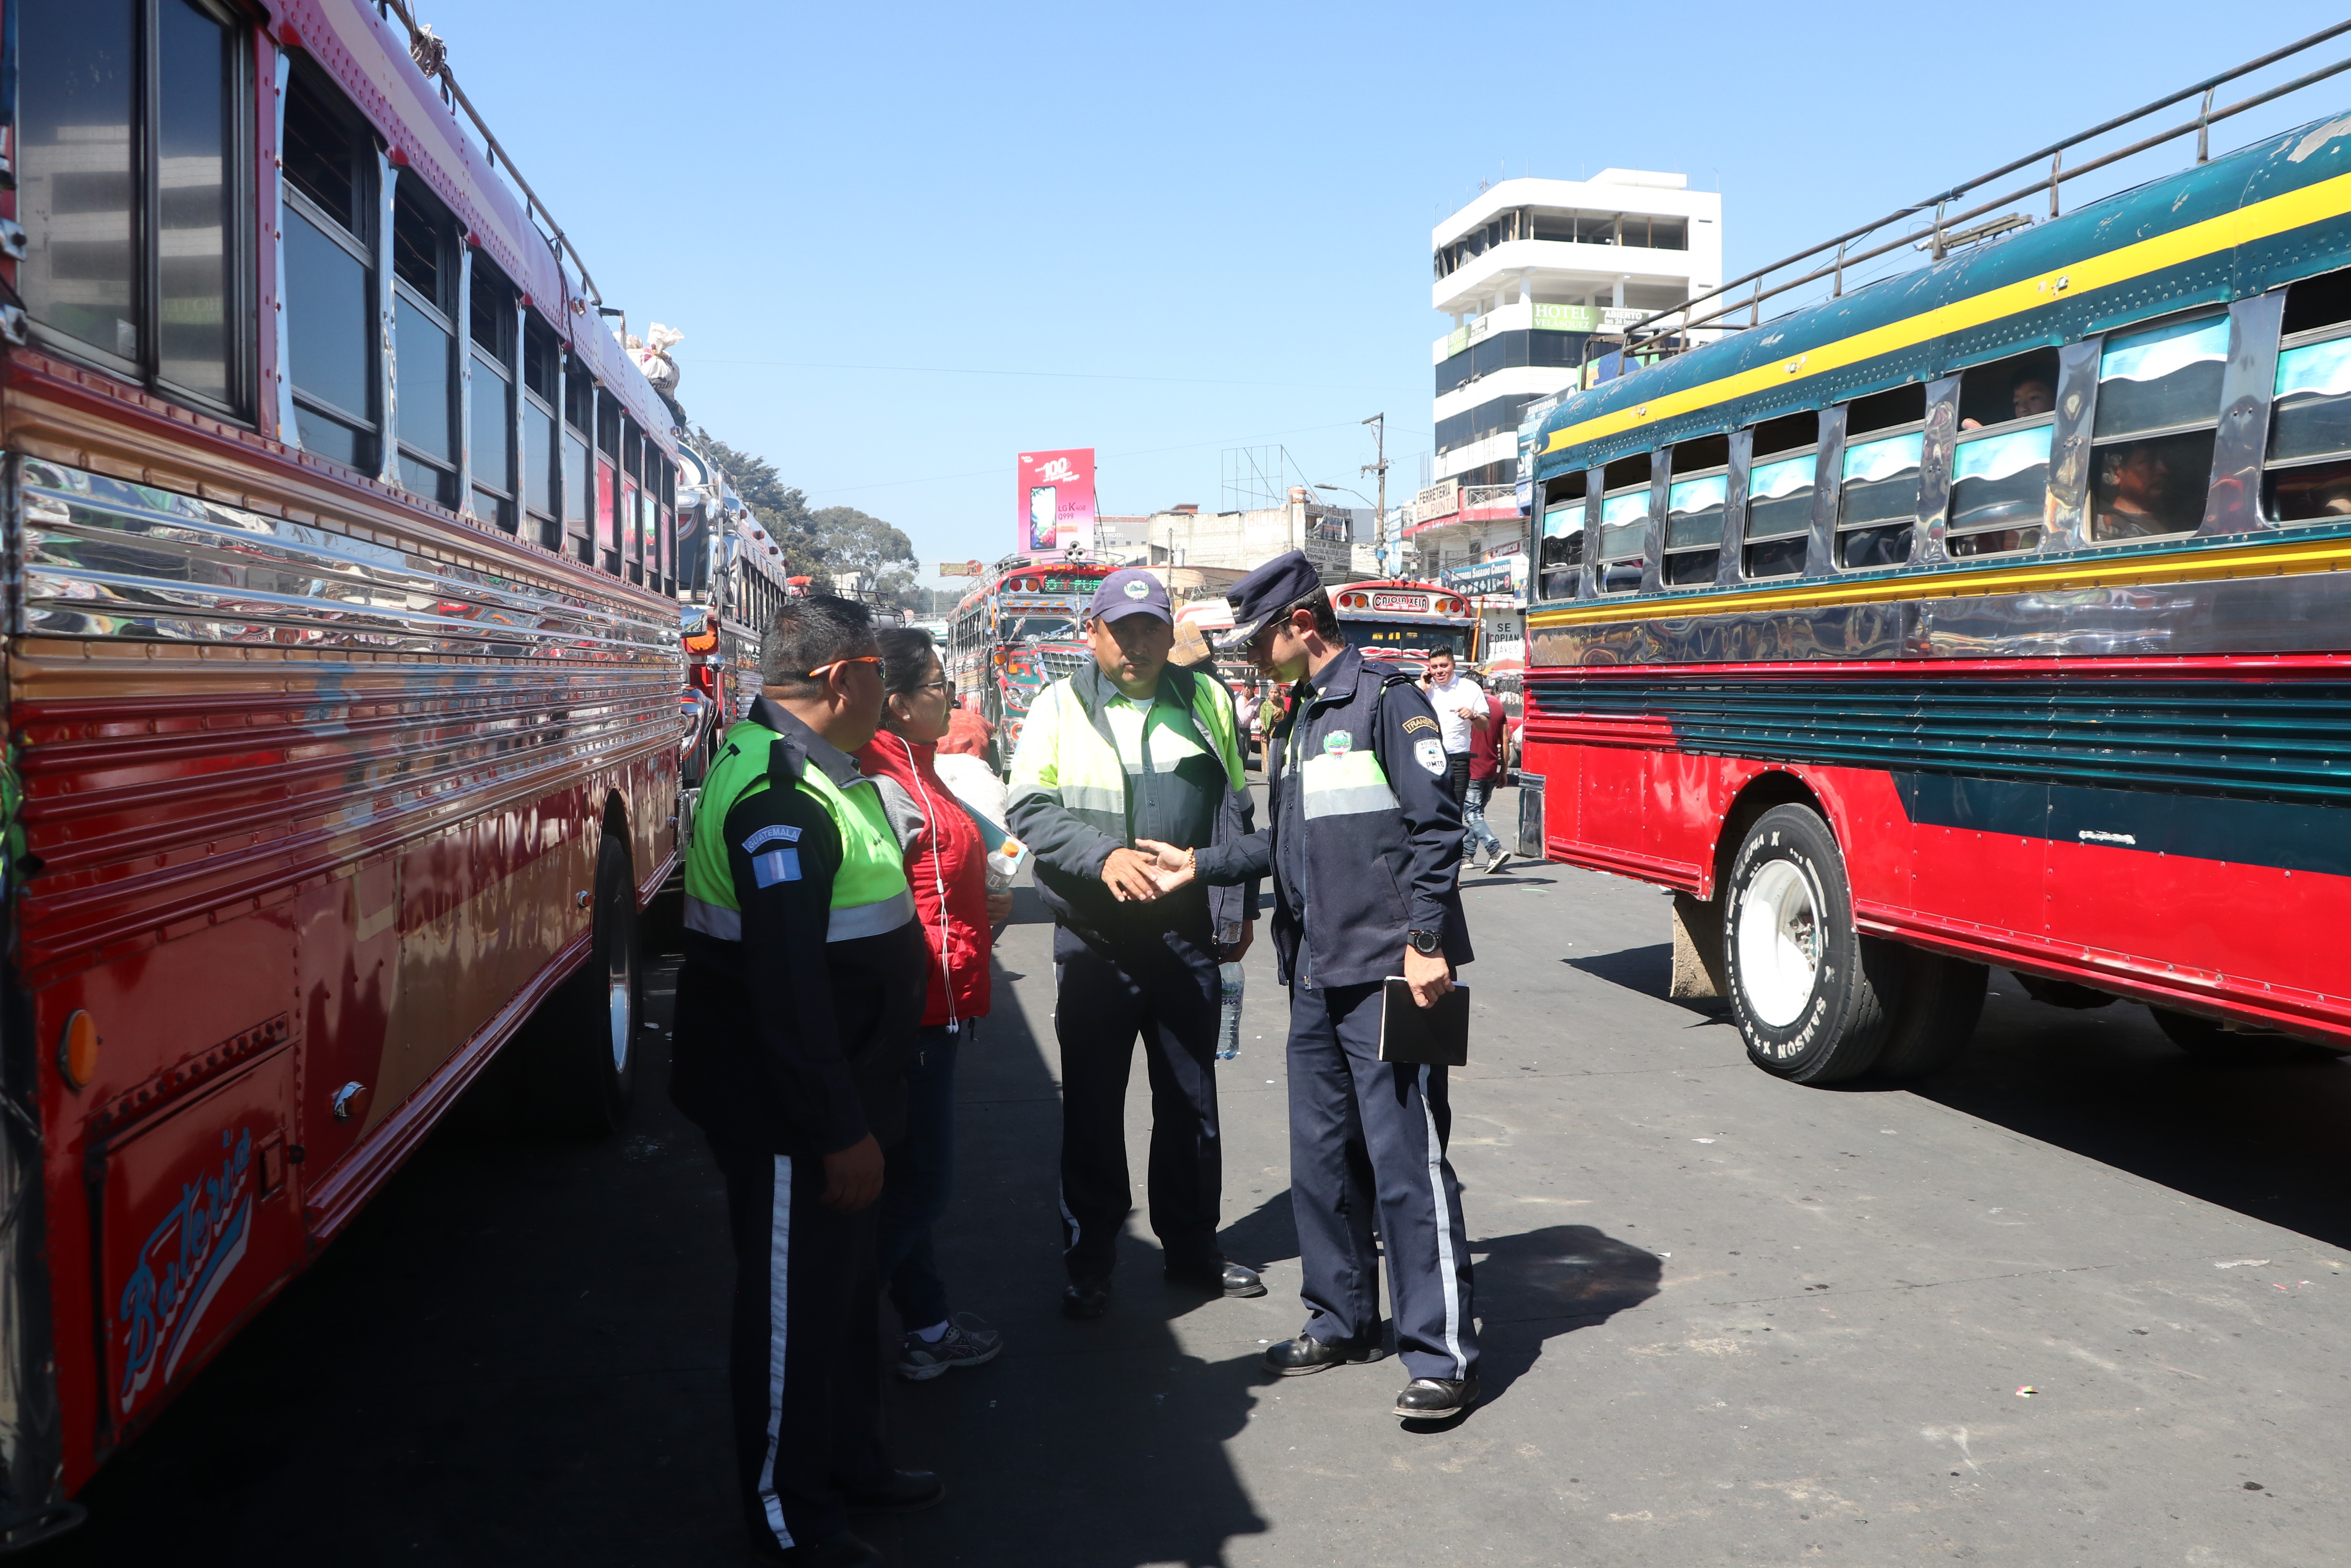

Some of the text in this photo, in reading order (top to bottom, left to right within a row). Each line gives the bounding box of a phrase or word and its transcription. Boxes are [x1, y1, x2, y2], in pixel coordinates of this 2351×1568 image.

[1535, 304, 1589, 320] HOTEL
[1604, 310, 1643, 319] ABIERTO
[1449, 326, 1467, 346] HOTEL
[1527, 397, 1557, 416] SURTIDORA
[1043, 457, 1067, 478] 100
[1419, 483, 1451, 505] FERRETERIA
[1273, 508, 1302, 526] XEA
[1308, 505, 1323, 513] BICI
[1417, 496, 1456, 520] EL PUNTO
[1451, 562, 1510, 582] SURTIDORA SAGRADO CORAZÓN
[1375, 595, 1427, 609] CAJOLA XELA
[1497, 623, 1511, 632] SE
[1490, 633, 1519, 642] COPIAN
[1489, 645, 1519, 654] LLAVES
[748, 828, 797, 848] GUATEMALA
[1777, 996, 1826, 1059] SAMSON
